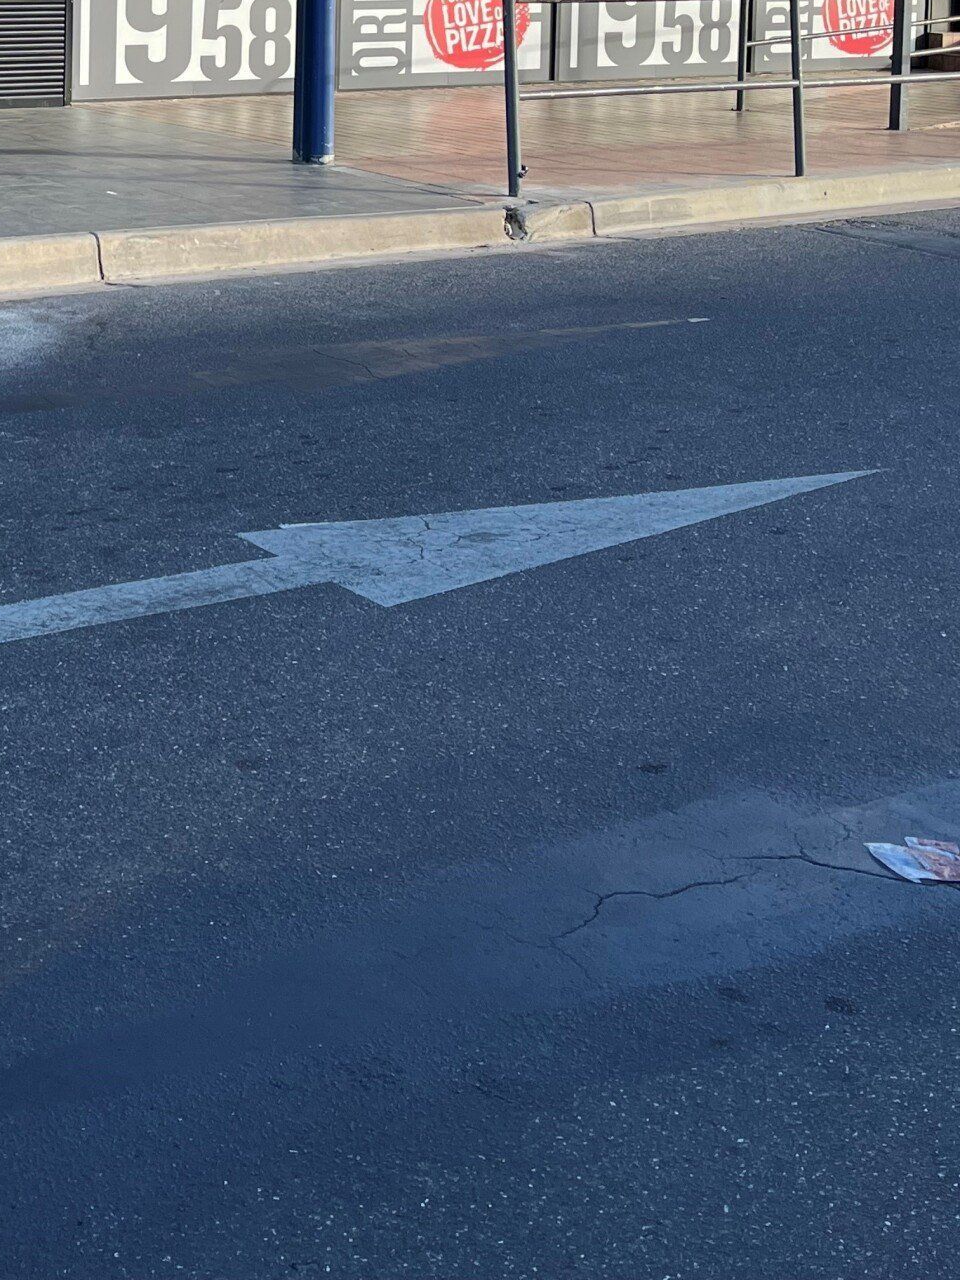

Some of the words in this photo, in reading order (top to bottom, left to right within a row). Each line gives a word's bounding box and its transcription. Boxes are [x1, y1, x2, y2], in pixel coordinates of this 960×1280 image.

[442, 0, 494, 29] LOVE
[494, 6, 505, 21] O
[839, 12, 890, 42] PIZZA
